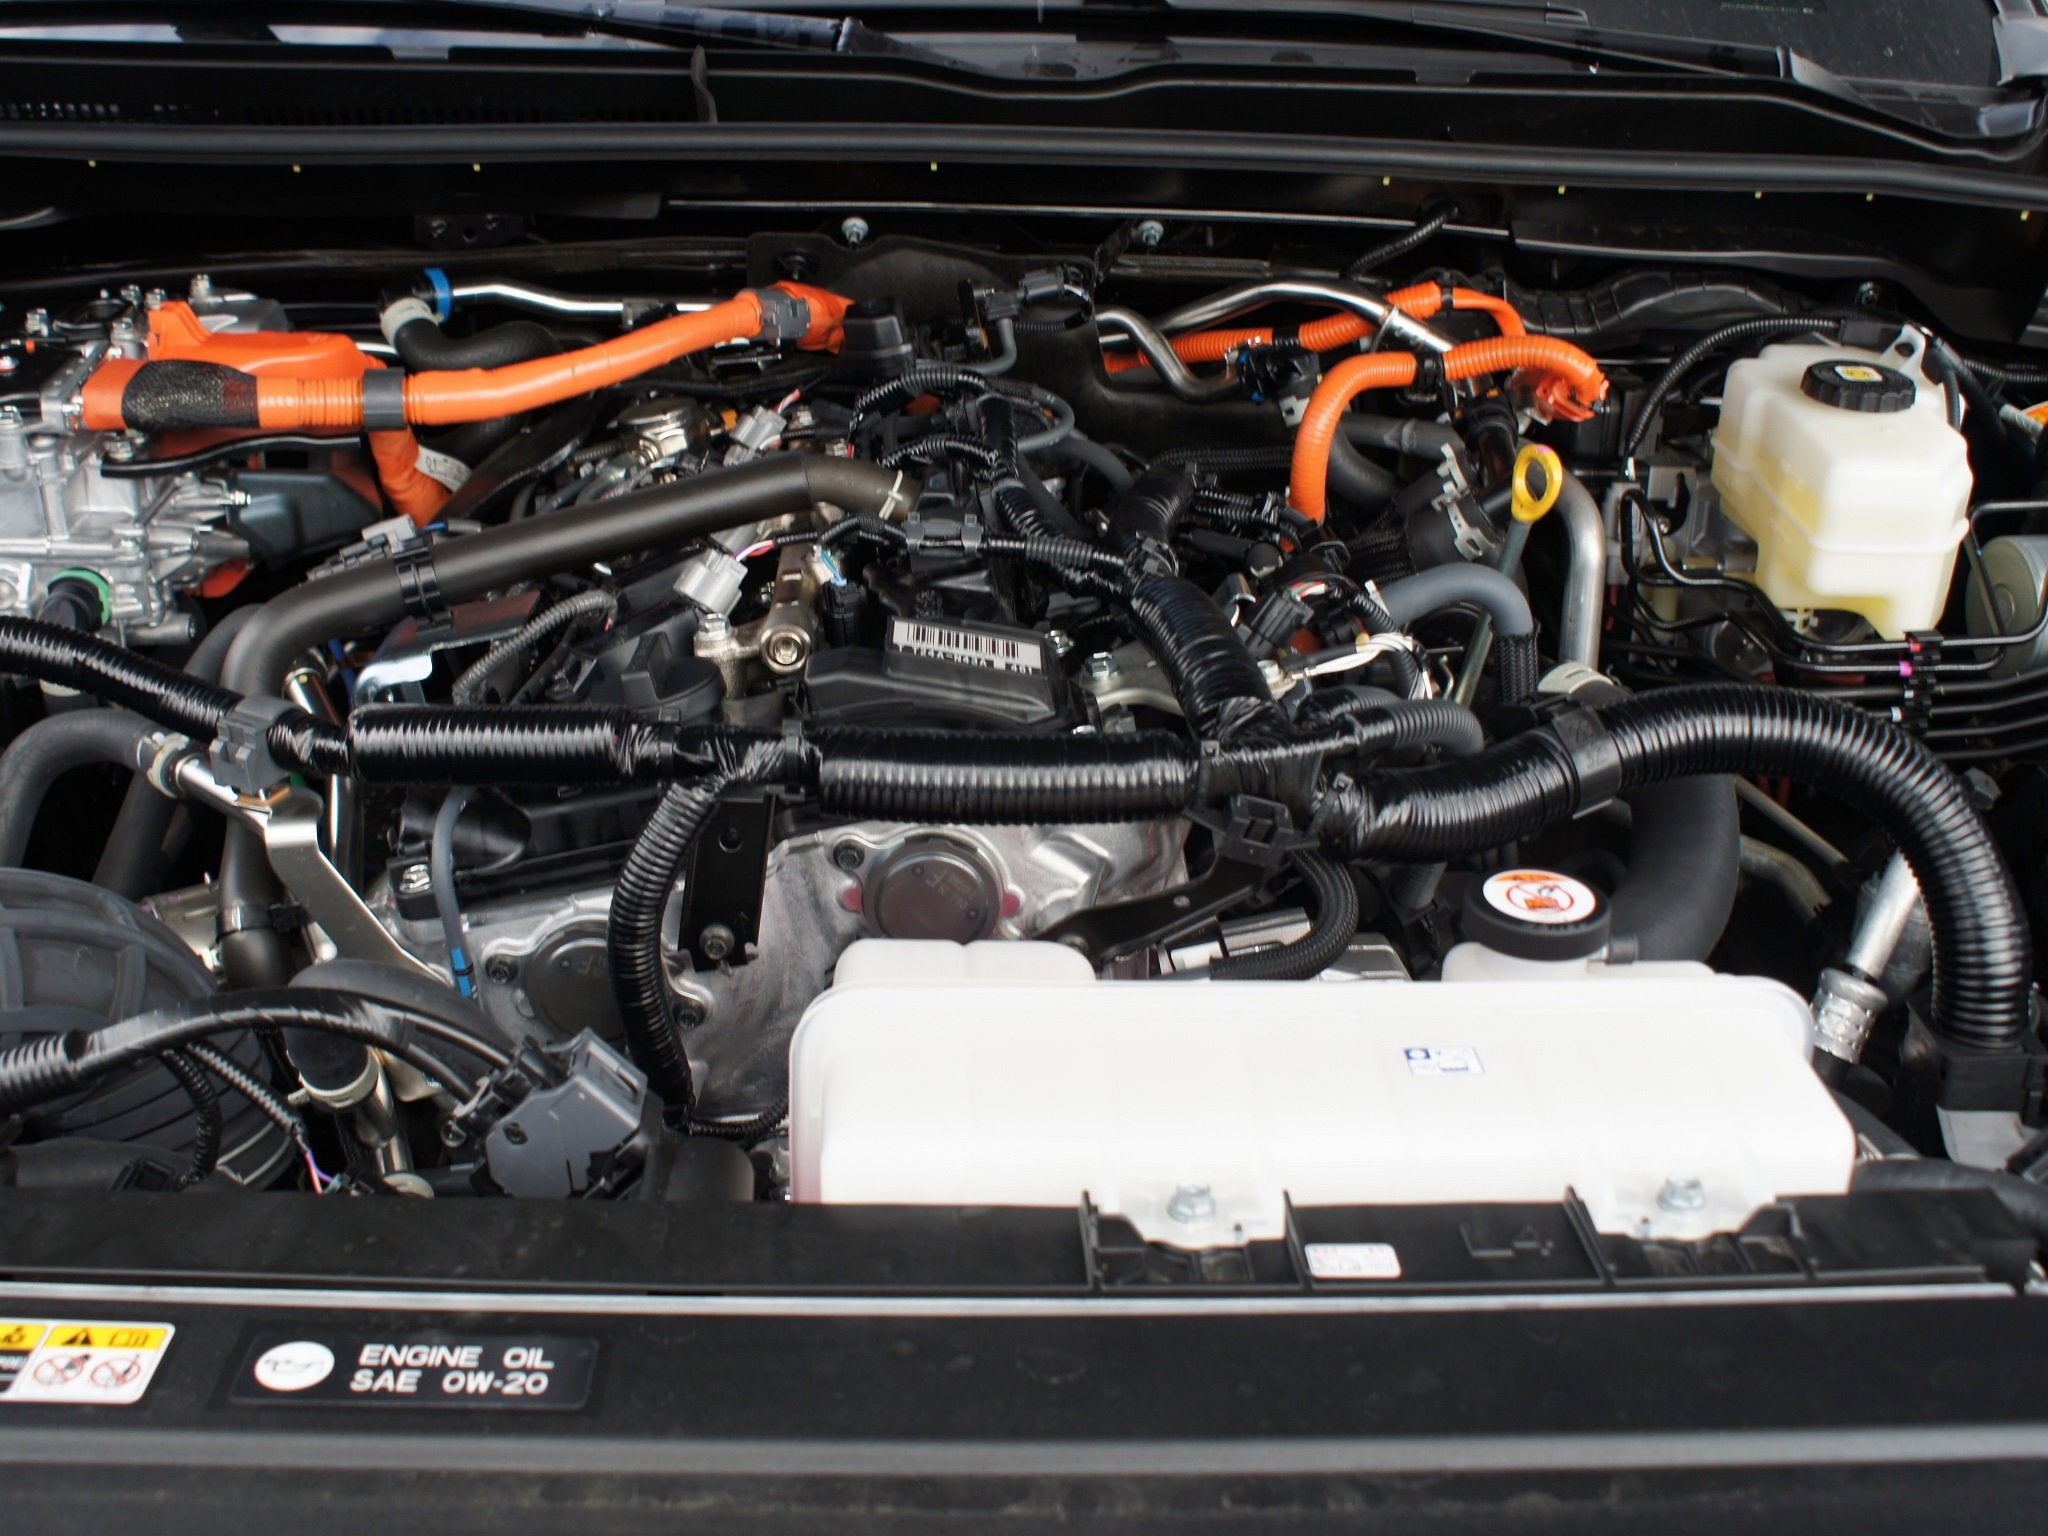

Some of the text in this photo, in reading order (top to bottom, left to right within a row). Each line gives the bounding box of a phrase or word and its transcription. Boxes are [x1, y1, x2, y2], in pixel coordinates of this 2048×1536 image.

[359, 1343, 555, 1370] ENGINE OIL
[350, 1368, 423, 1393] SAE
